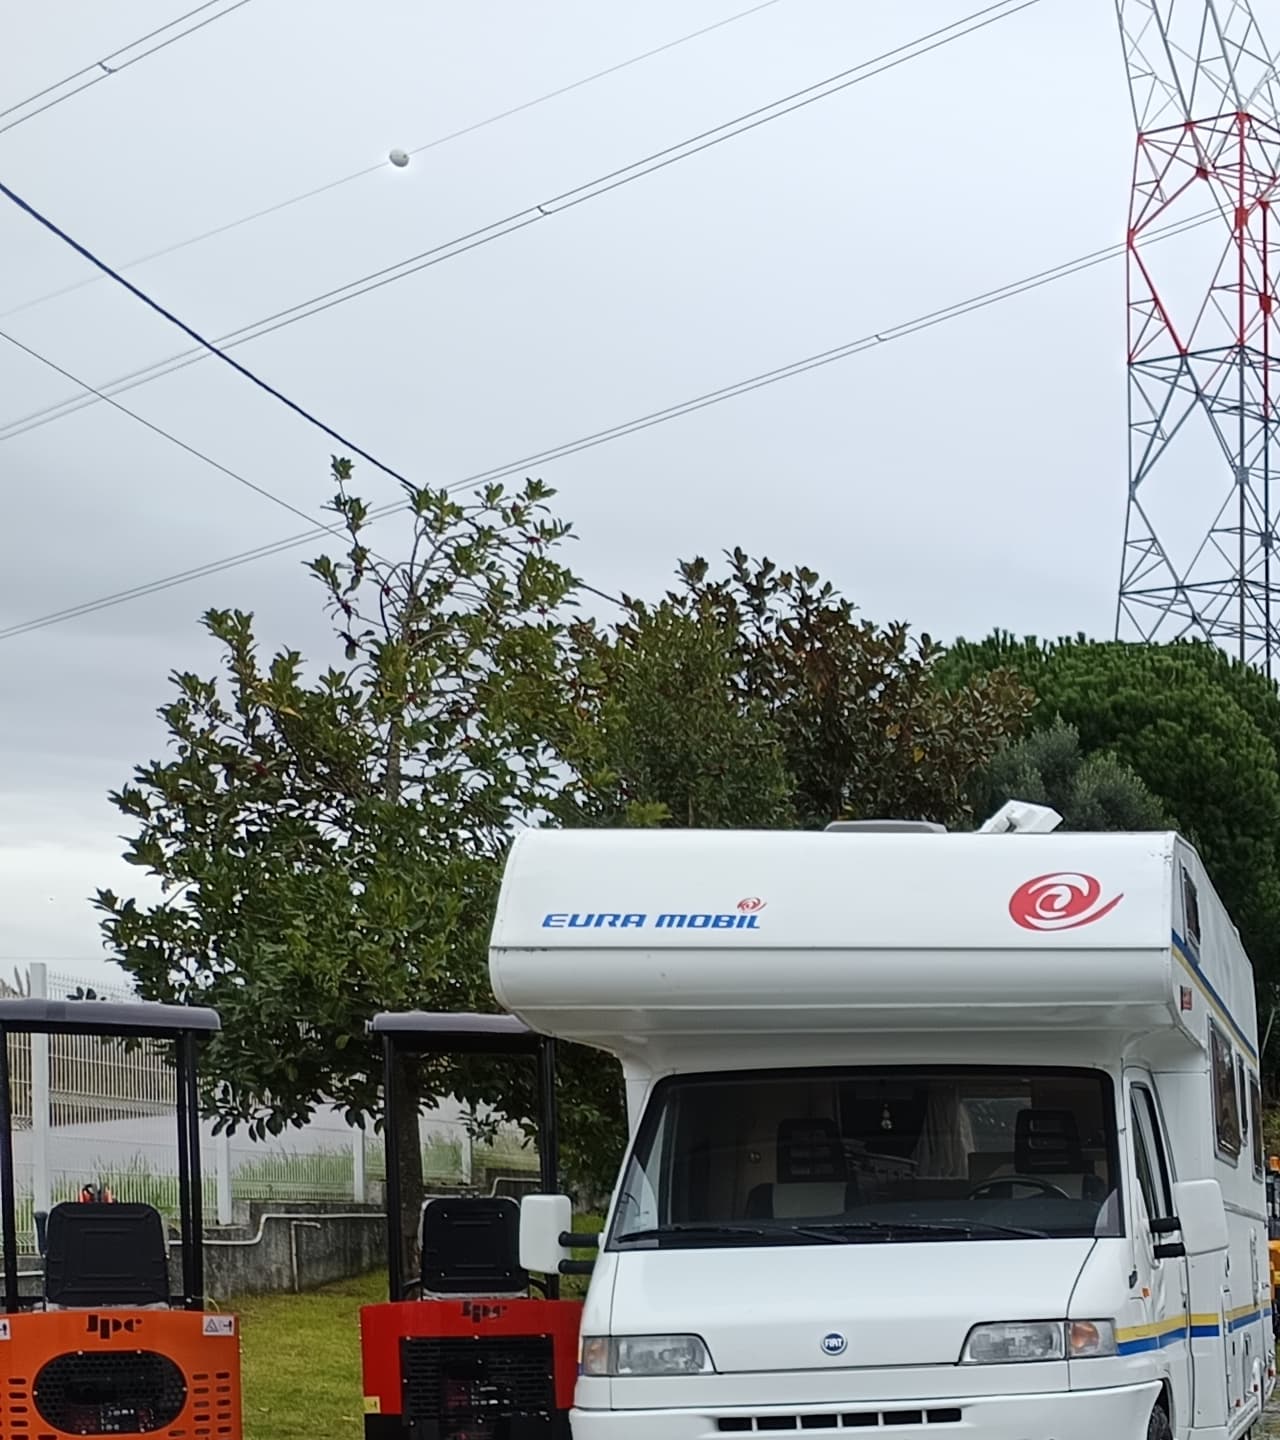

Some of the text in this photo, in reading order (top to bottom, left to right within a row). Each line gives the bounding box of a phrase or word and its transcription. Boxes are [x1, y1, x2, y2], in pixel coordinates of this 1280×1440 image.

[542, 914, 760, 929] EURA MOBIL
[825, 1338, 843, 1348] FIAT
